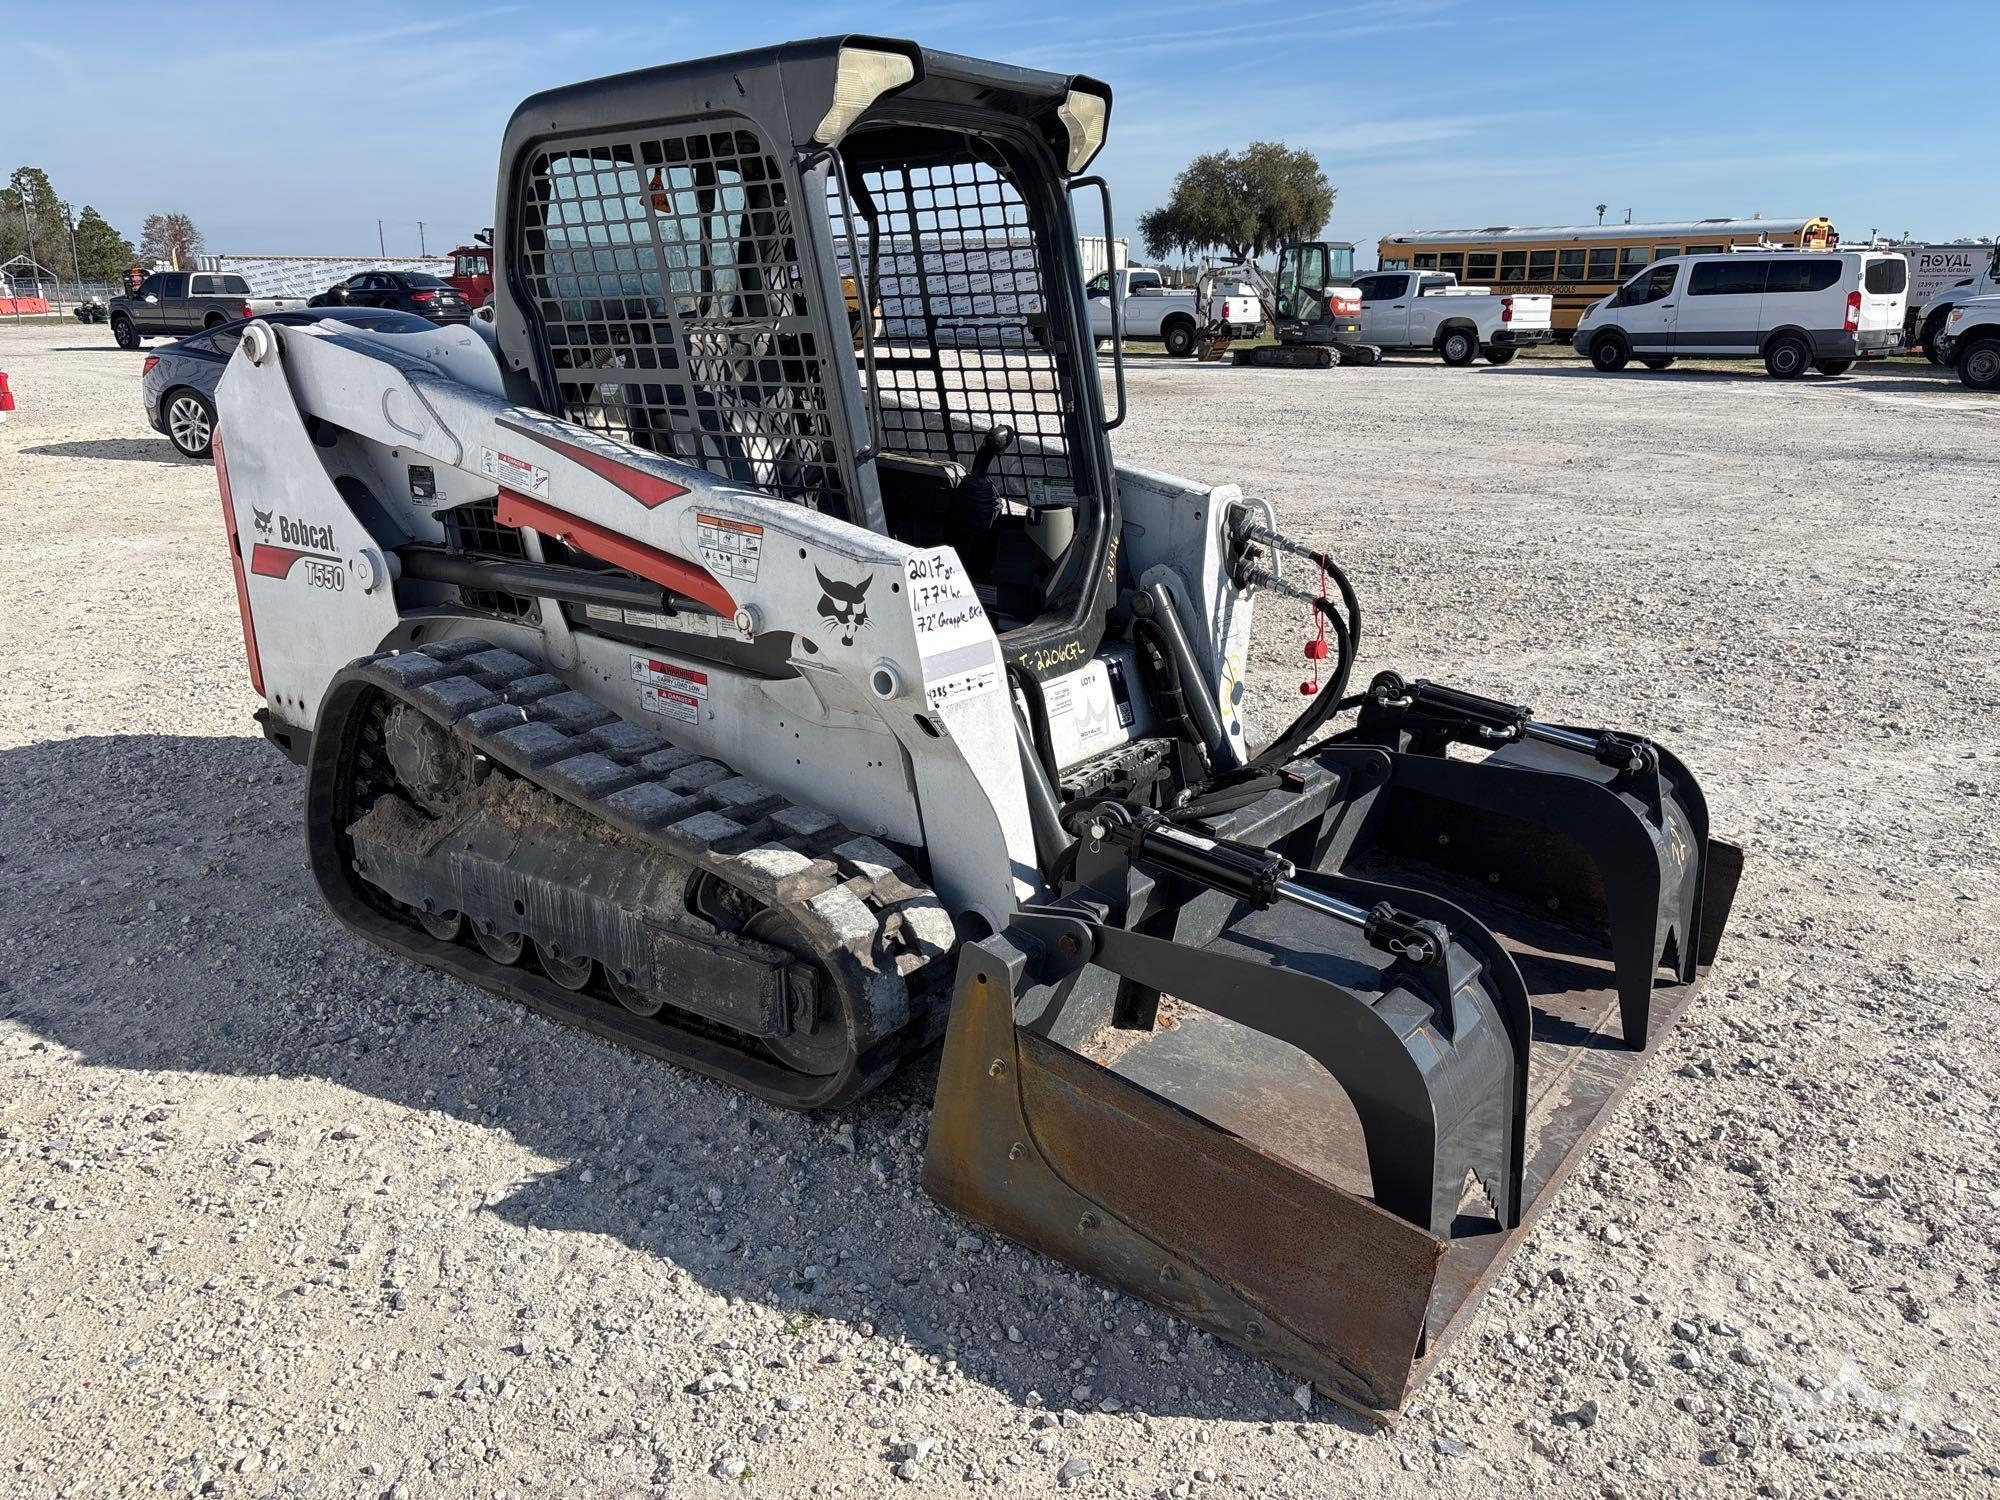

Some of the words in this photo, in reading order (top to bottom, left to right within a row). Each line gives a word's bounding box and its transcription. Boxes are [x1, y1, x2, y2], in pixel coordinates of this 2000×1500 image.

[1920, 254, 1972, 267] ROYAL
[1500, 286, 1521, 294] TAYLOR
[1523, 286, 1546, 294] COUNTY
[1547, 285, 1576, 293] SCHOOLS
[279, 515, 335, 552] Bobcat
[908, 555, 945, 580] 2017
[304, 561, 345, 592] T550
[913, 584, 948, 612] 1,774
[938, 611, 969, 629] Grapple
[664, 664, 695, 680] WARNING
[656, 676, 673, 685] CARRY
[674, 680, 688, 689] LOAD
[1080, 677, 1091, 686] LOT
[667, 692, 693, 705] DANGER
